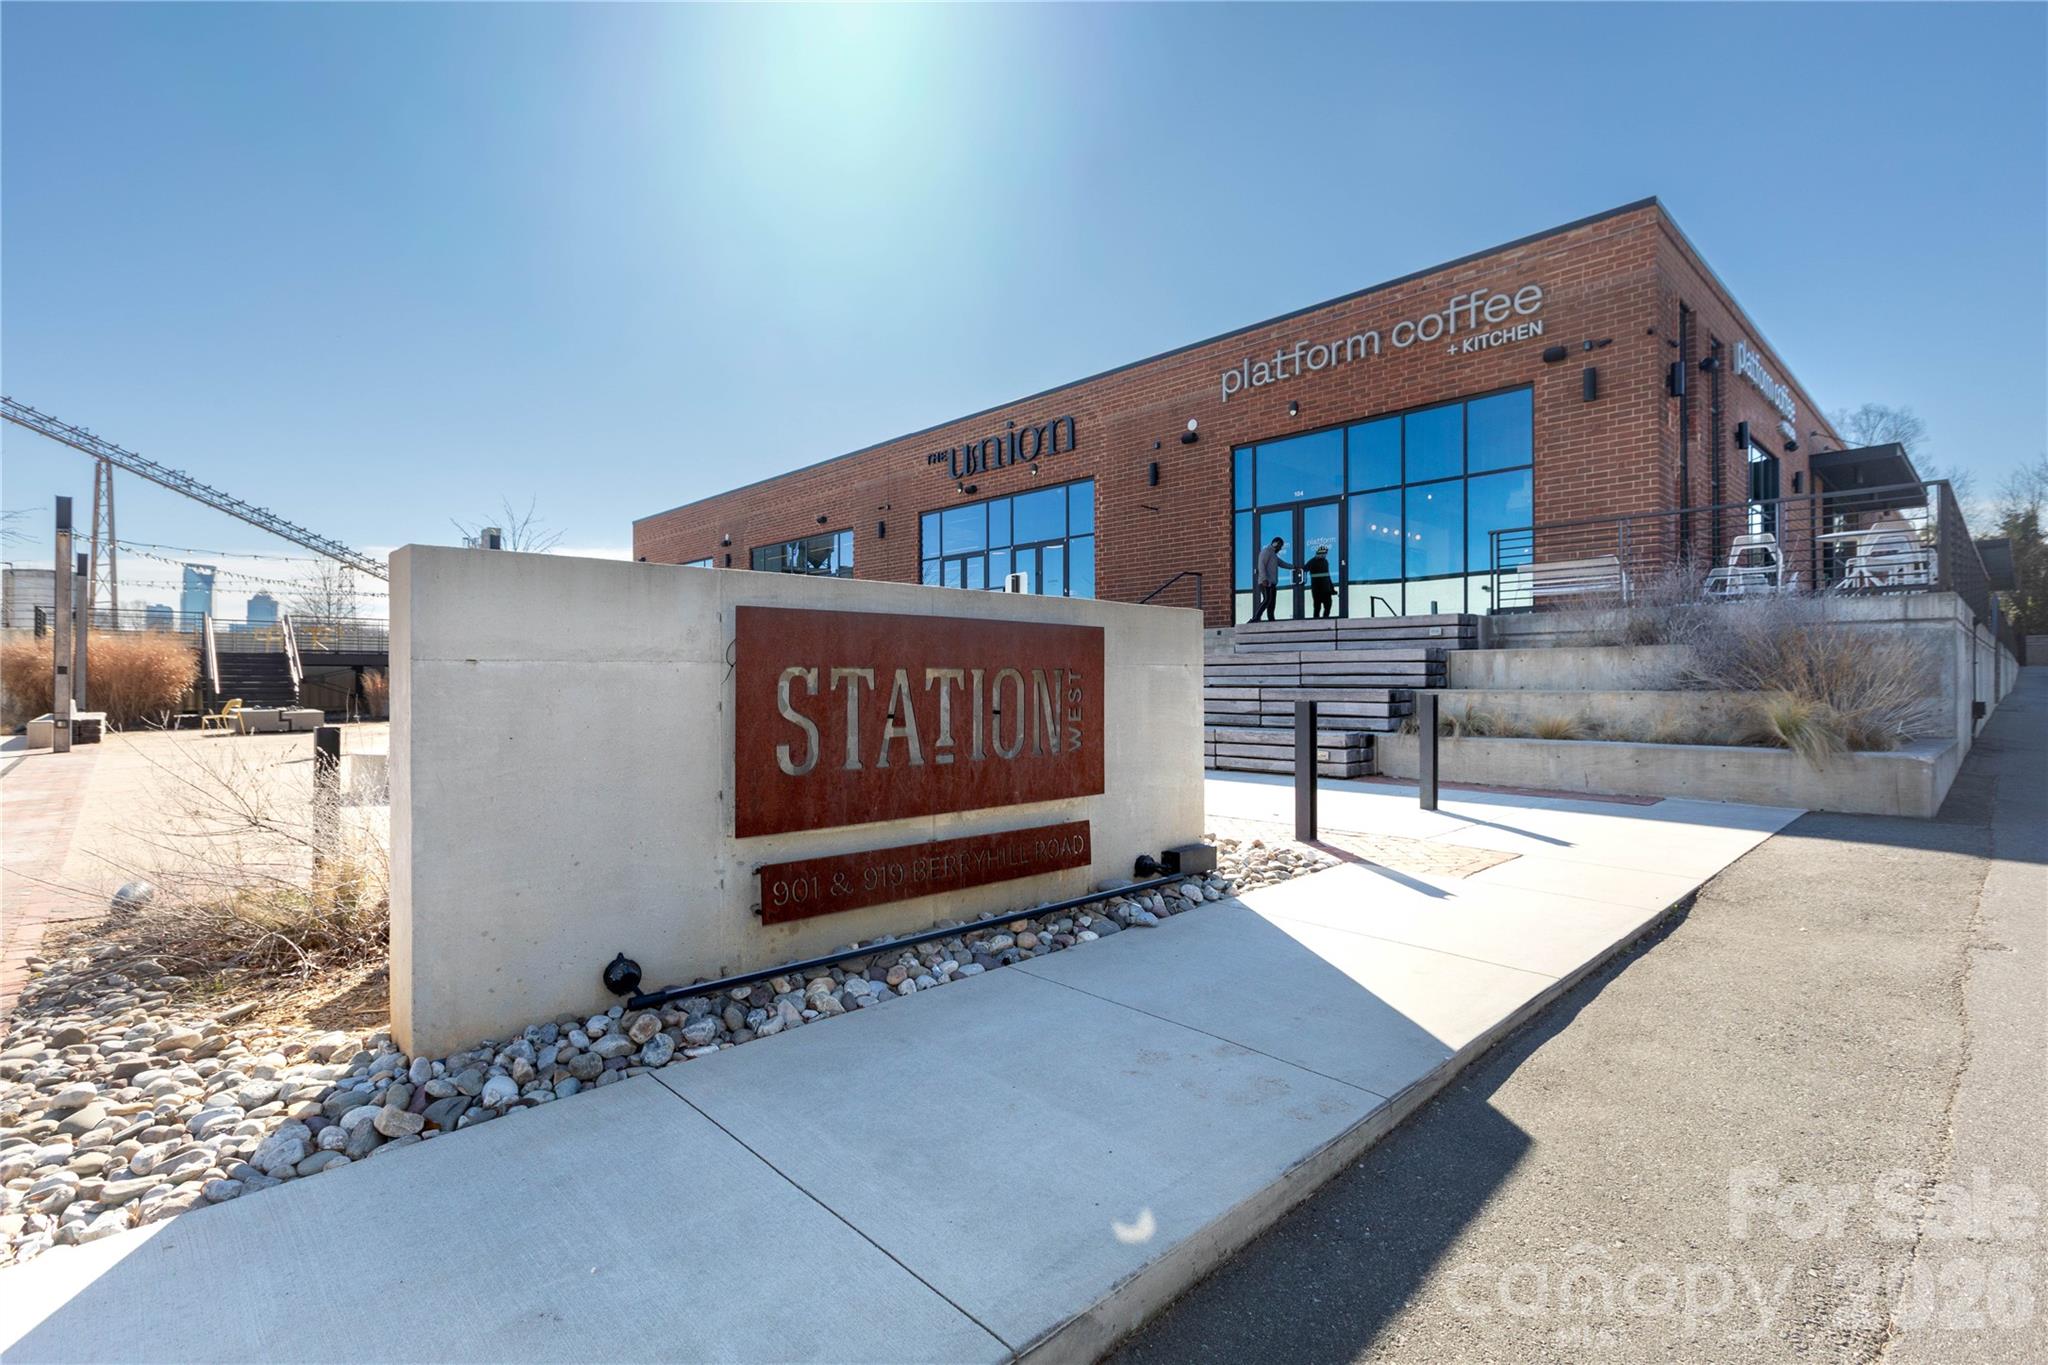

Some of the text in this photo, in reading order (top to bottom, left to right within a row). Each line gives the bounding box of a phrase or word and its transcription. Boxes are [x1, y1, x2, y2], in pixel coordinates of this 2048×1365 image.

[1221, 284, 1544, 402] platform coffee
[1463, 320, 1544, 354] KITCHEN
[927, 414, 1077, 480] THE union
[776, 666, 1065, 777] STATION
[1068, 665, 1084, 752] WEST
[773, 834, 1085, 907] 901 & 919 BERRYHILL ROAD
